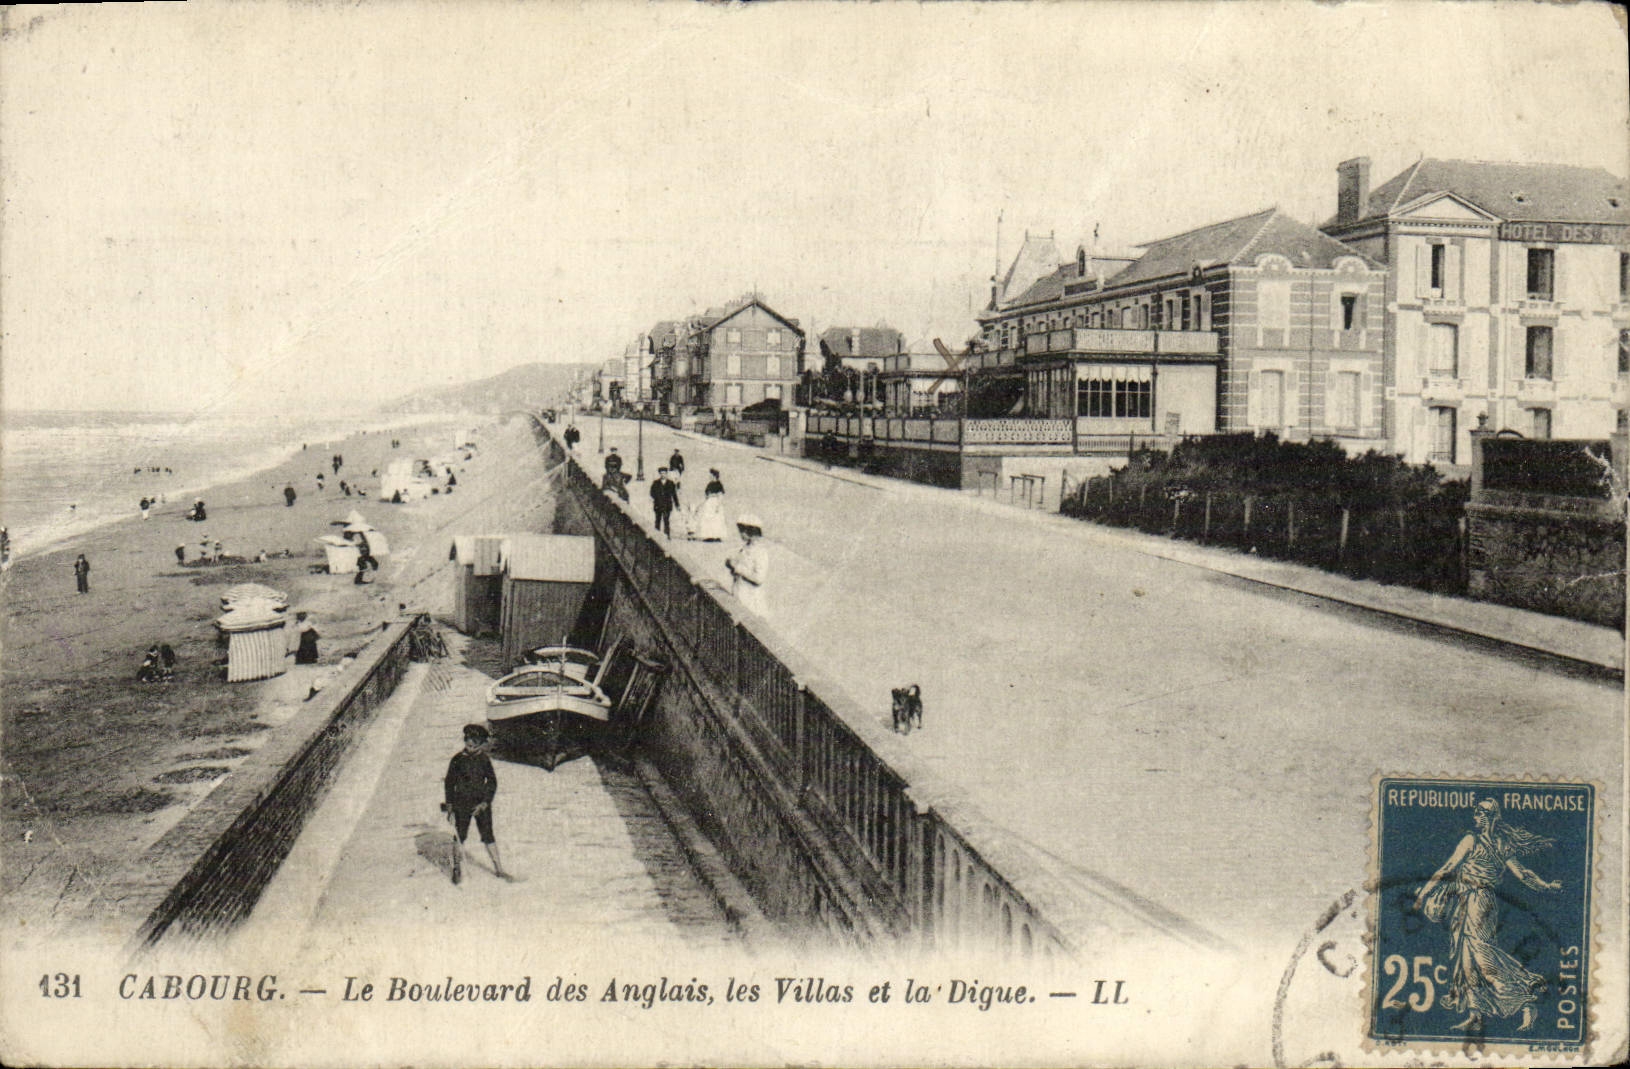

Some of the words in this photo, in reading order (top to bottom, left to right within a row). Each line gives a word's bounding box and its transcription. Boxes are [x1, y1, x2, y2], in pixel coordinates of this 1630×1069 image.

[1501, 222, 1552, 240] HOTEL
[1562, 225, 1594, 241] DES
[1388, 788, 1476, 810] REPUBLIQUE
[1557, 945, 1580, 1029] POSTES
